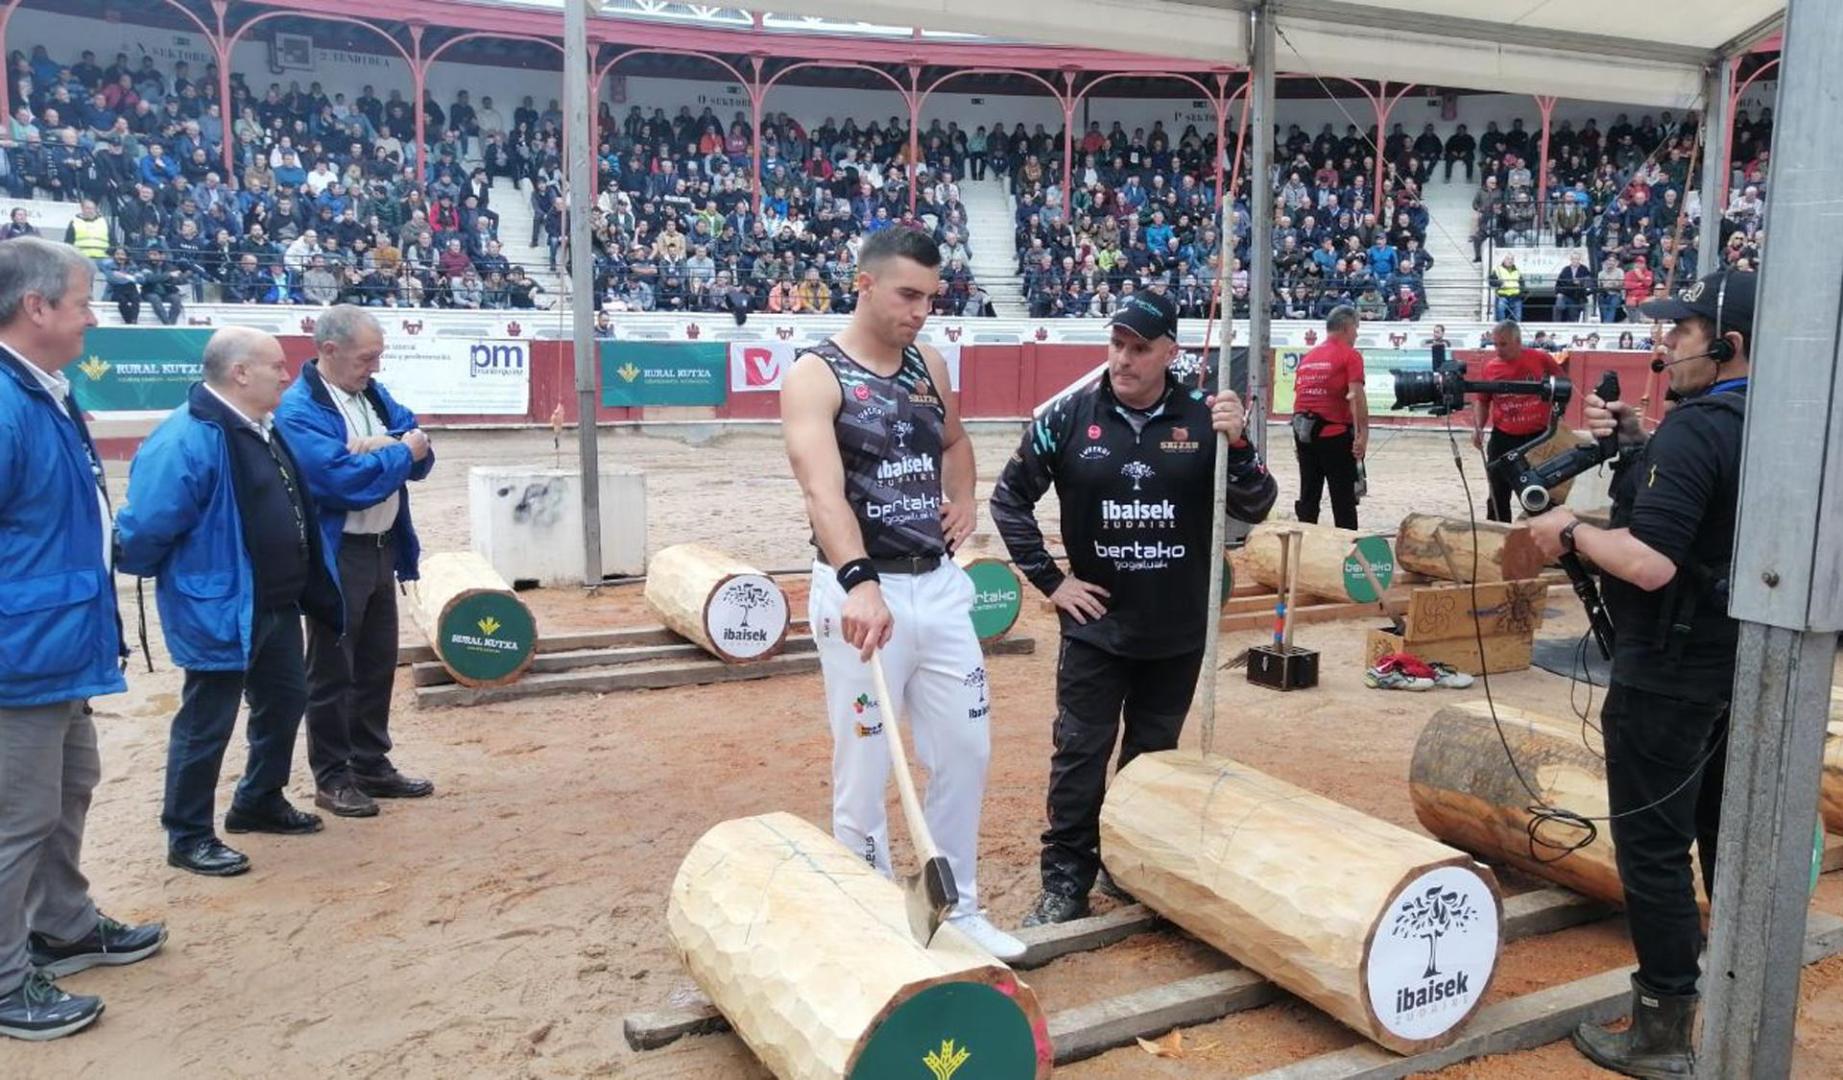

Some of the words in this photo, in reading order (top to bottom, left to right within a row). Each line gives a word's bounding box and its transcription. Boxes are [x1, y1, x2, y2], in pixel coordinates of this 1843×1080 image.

[116, 363, 160, 375] RURAL
[643, 368, 675, 378] RURAL
[677, 369, 712, 378] KUTXA
[877, 453, 935, 479] ibaisek
[1102, 499, 1175, 520] ibaisek
[1102, 521, 1176, 529] ZUDAIRE
[1094, 540, 1185, 558] bertako
[1345, 560, 1392, 572] beako
[975, 588, 1017, 604] rtako
[451, 634, 483, 646] RURAL
[484, 638, 519, 651] KUTXA
[723, 628, 768, 641] ibaisek
[1396, 969, 1469, 1014] ibaisek
